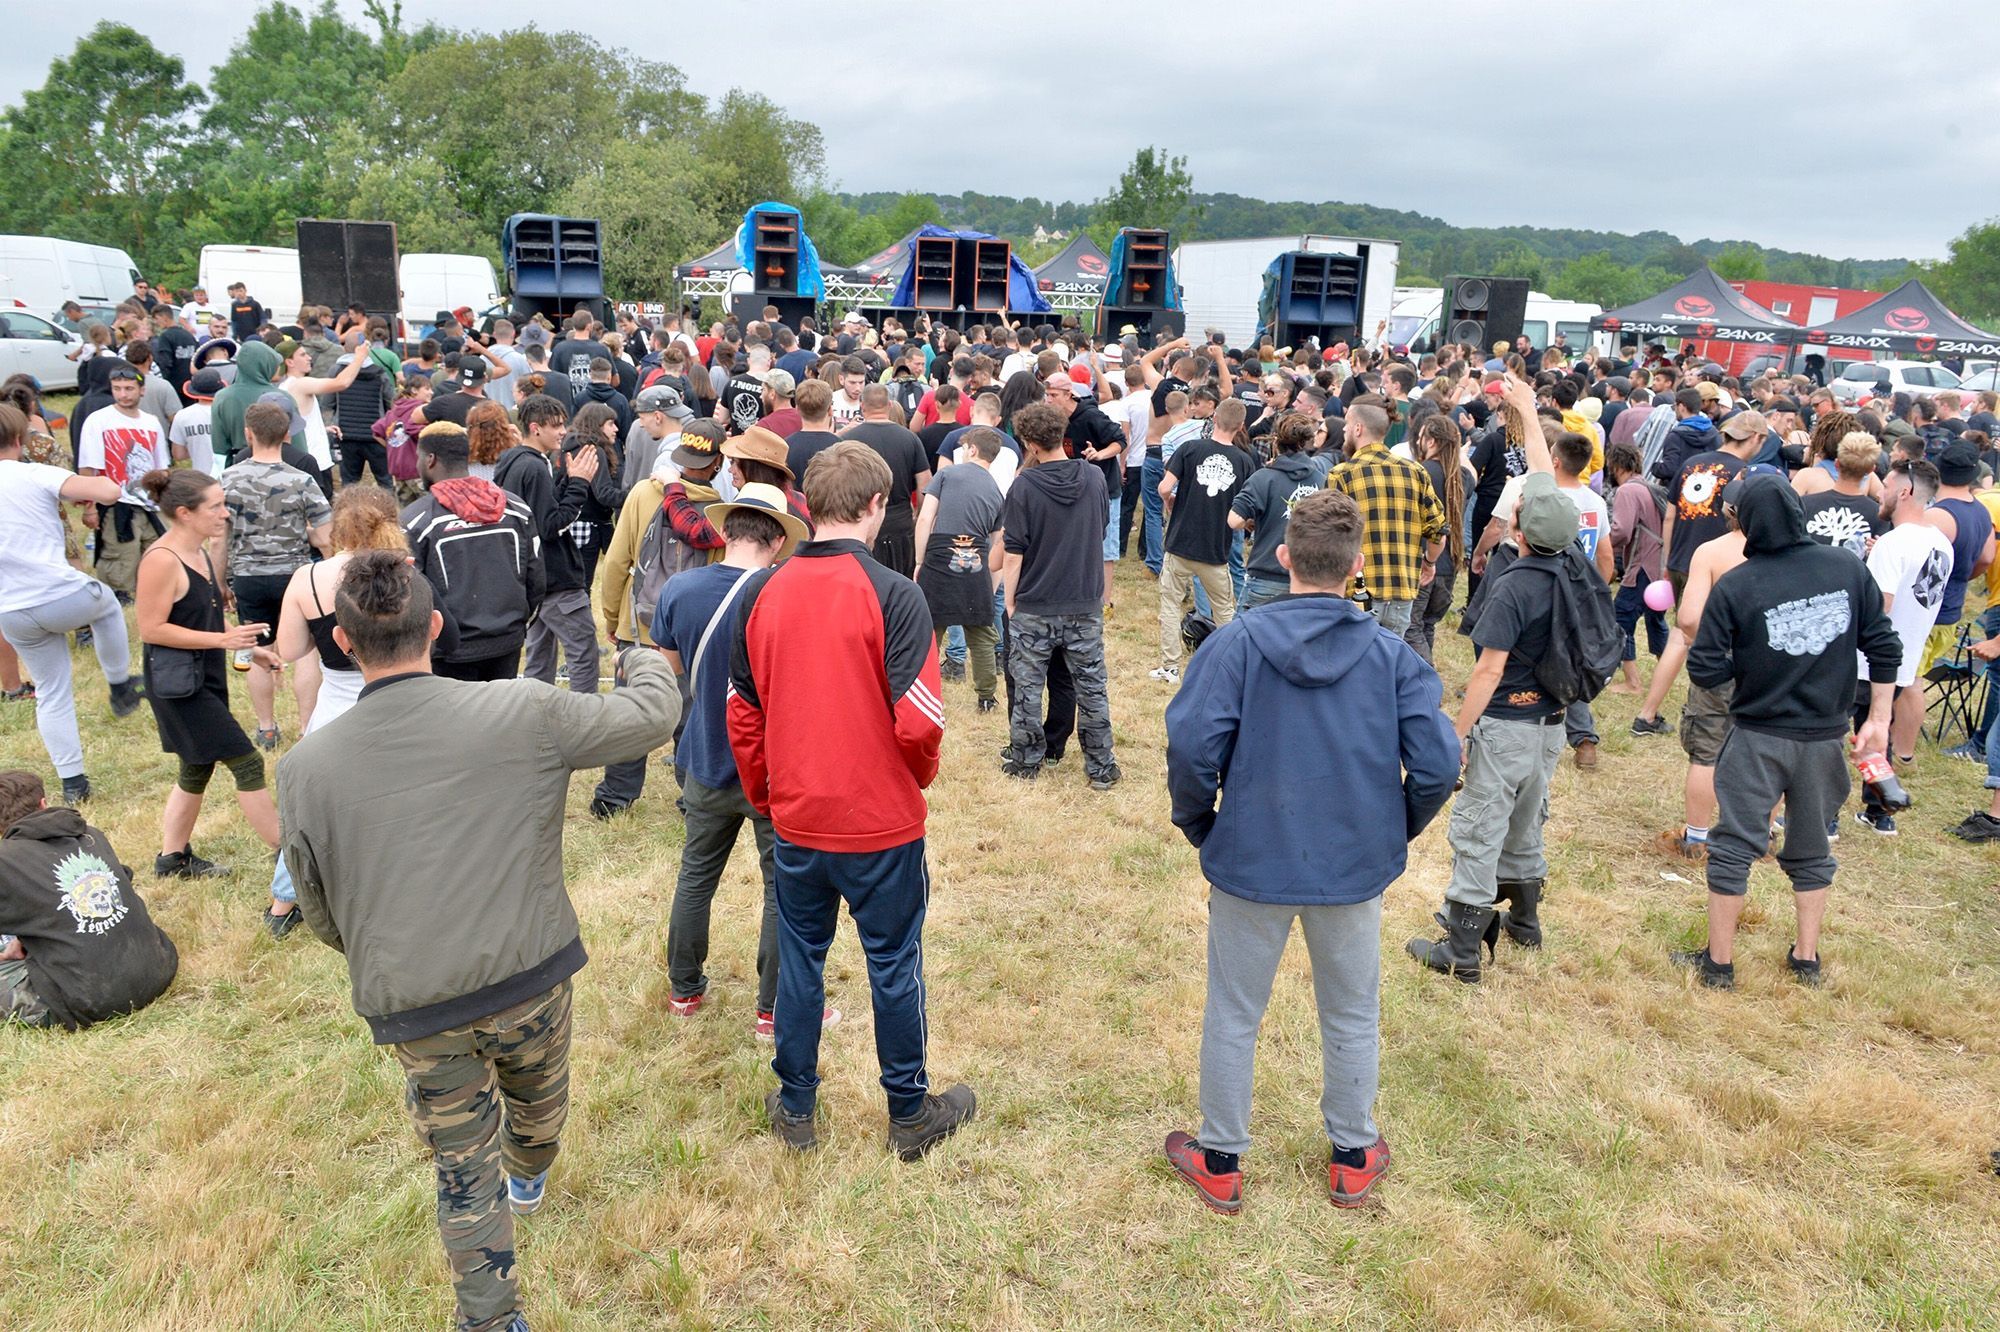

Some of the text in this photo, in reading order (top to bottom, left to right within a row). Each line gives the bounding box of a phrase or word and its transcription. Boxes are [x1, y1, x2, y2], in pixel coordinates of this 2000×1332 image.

[1055, 282, 1099, 292] 24MX
[619, 302, 638, 315] ACID
[1621, 322, 1678, 335] 24MX
[1715, 328, 1776, 342] 24MX
[1828, 335, 1891, 348] 24MX
[1937, 341, 2000, 355] 24MX
[730, 380, 763, 394] F.NOIZ
[680, 432, 713, 452] BOOM
